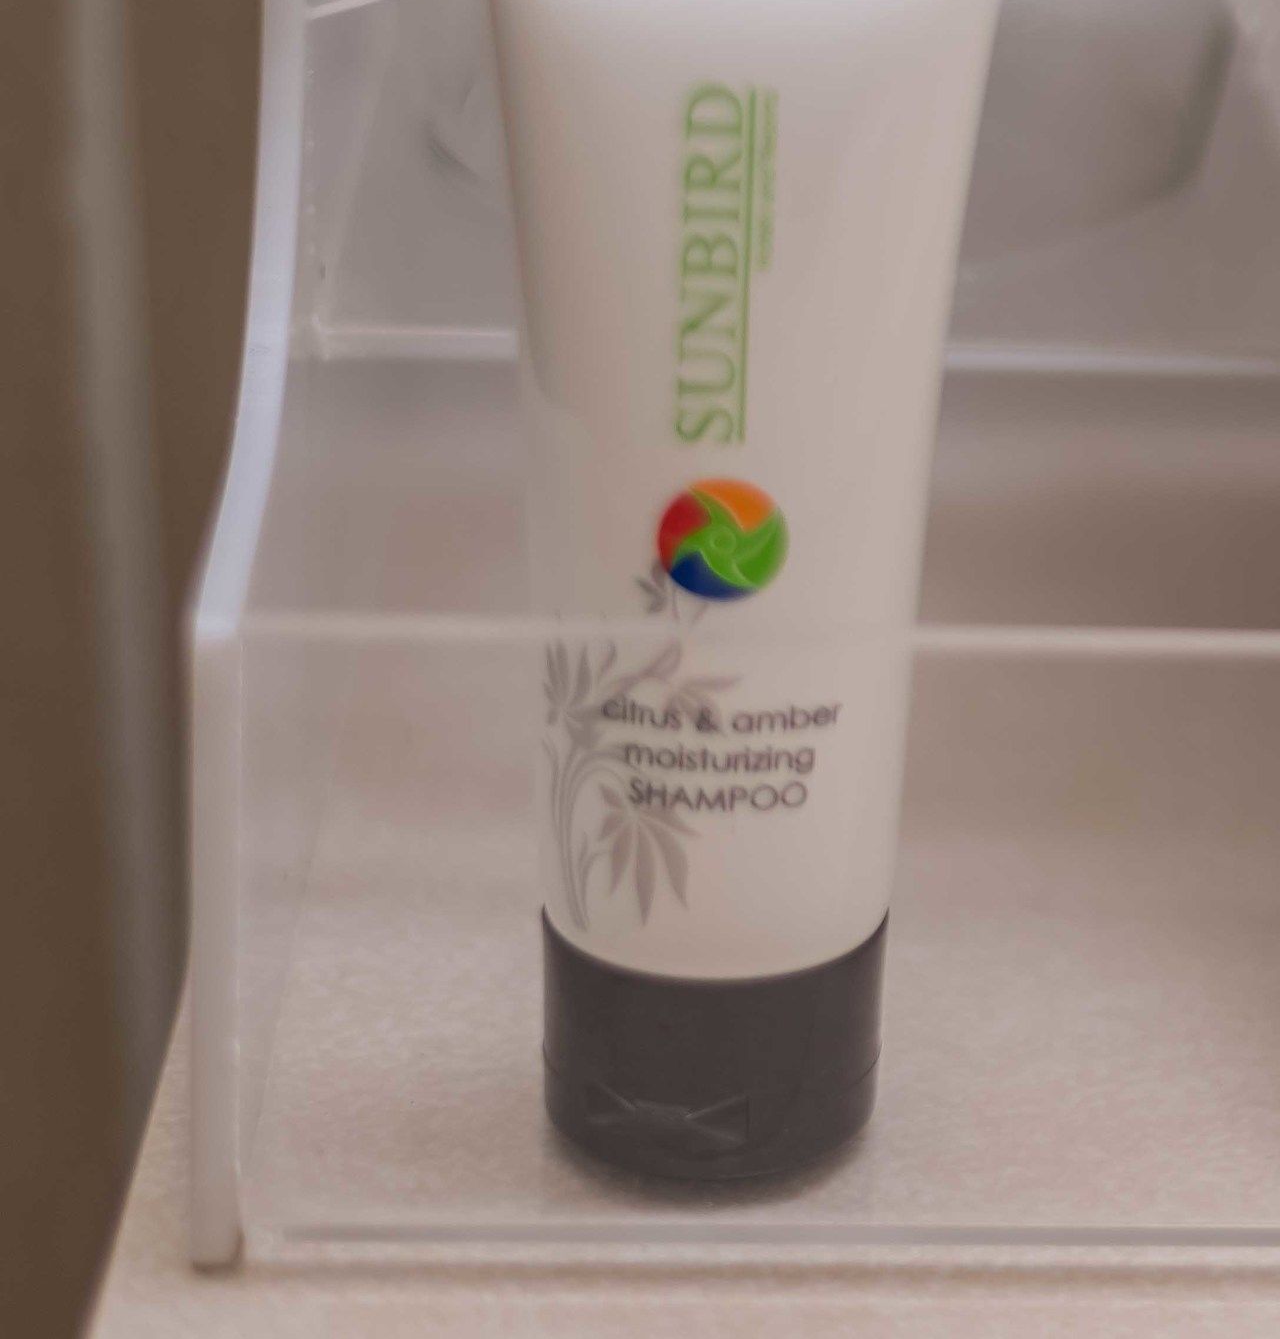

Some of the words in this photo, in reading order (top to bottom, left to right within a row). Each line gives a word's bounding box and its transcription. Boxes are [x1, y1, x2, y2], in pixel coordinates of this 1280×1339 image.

[675, 82, 745, 446] SUNBIRD
[602, 696, 682, 733] citrus
[694, 706, 723, 736] &
[732, 702, 843, 735] amber
[622, 742, 816, 776] moisturizing
[628, 779, 809, 813] SHAMPOO
